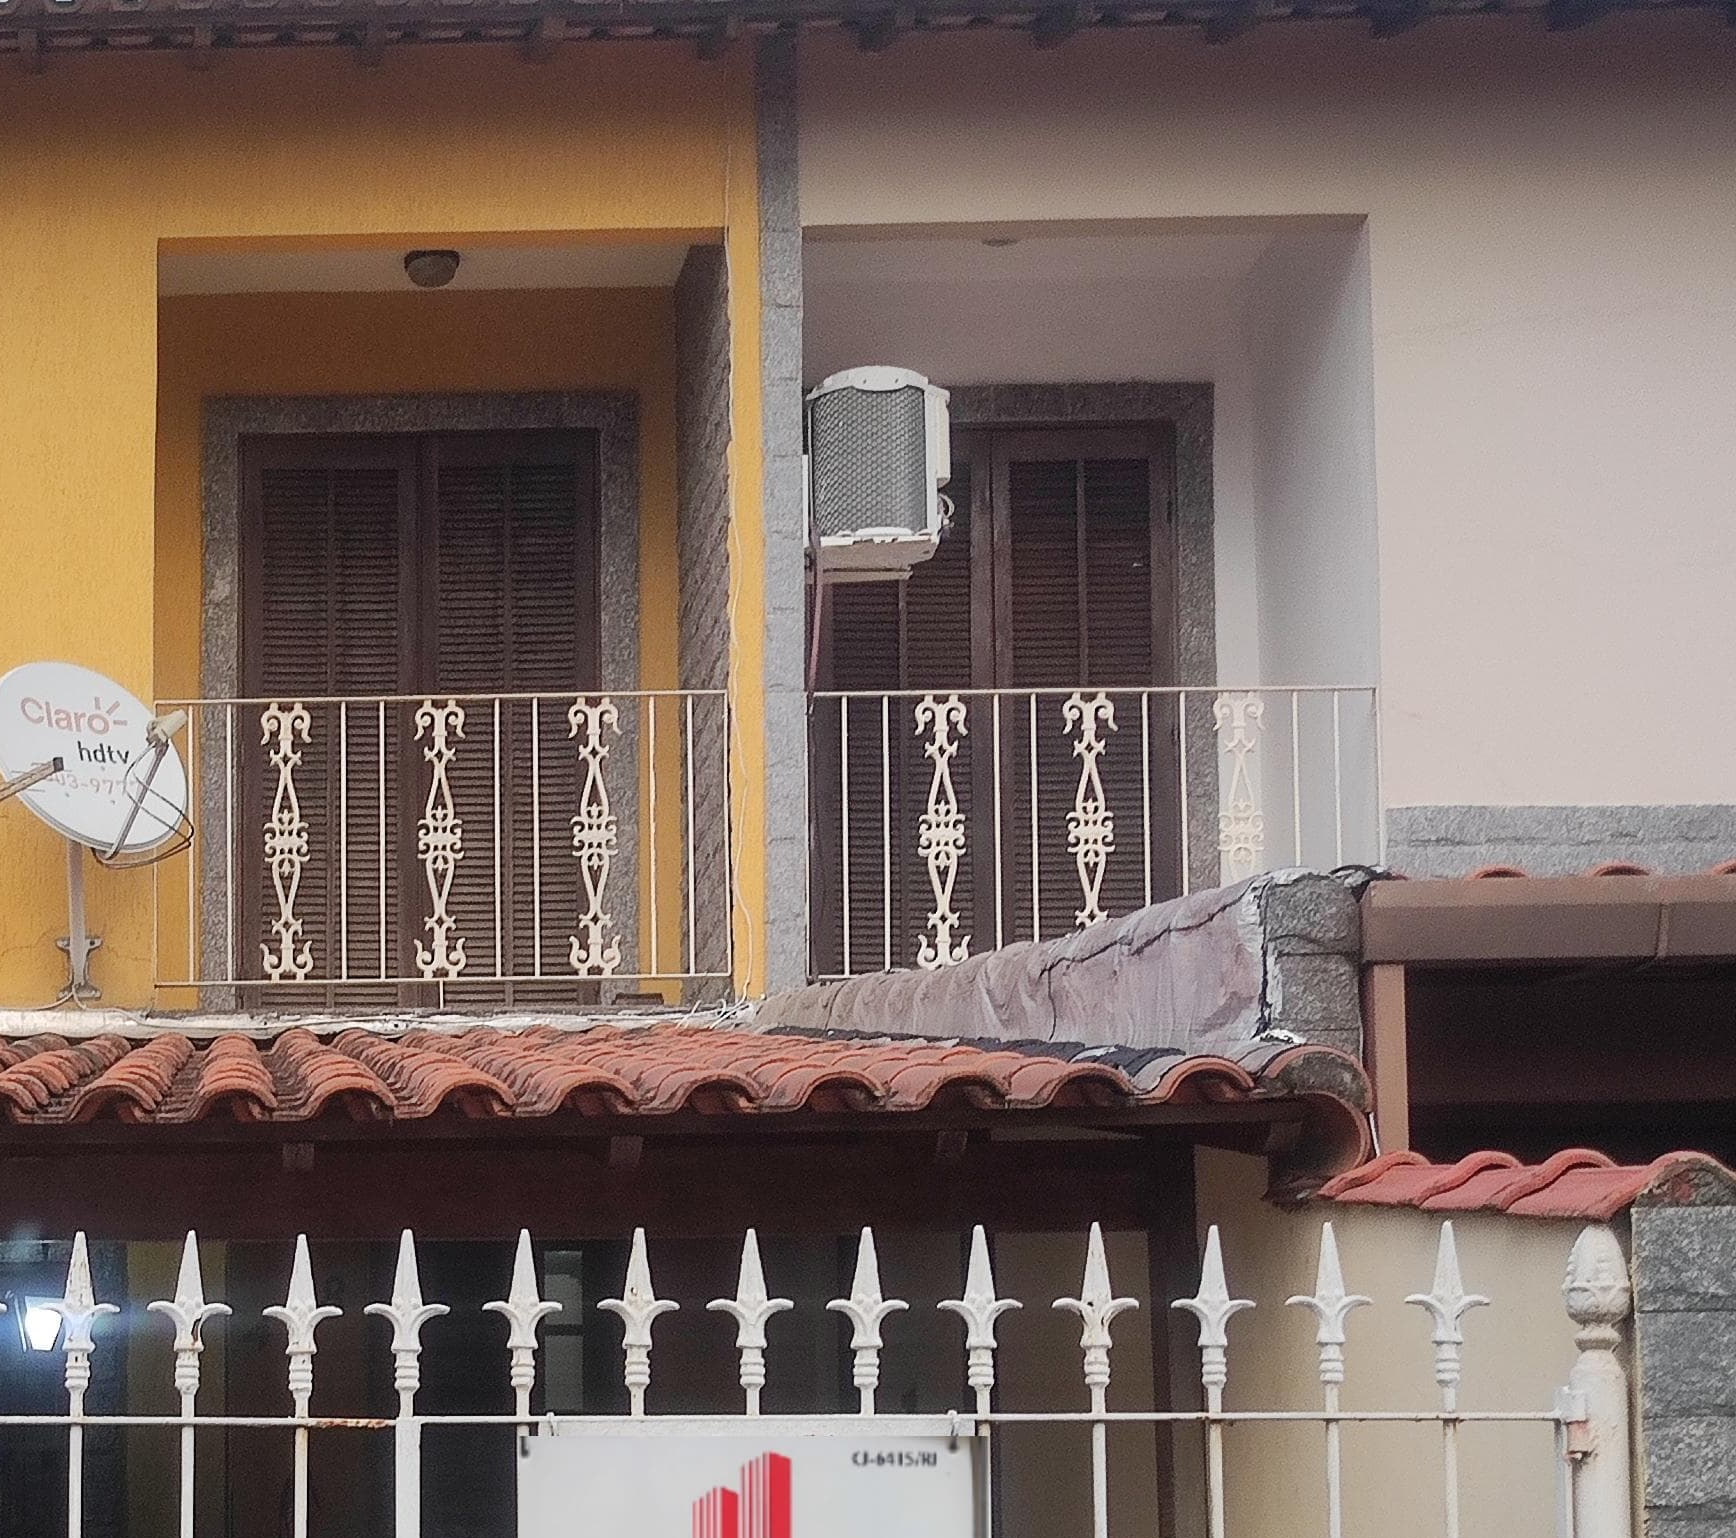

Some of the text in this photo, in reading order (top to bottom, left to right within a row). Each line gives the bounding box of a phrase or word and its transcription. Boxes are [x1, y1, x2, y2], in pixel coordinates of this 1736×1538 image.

[20, 697, 110, 735] Claro
[77, 740, 130, 765] hdtv
[851, 1451, 938, 1468] CJ-6415/RJ
